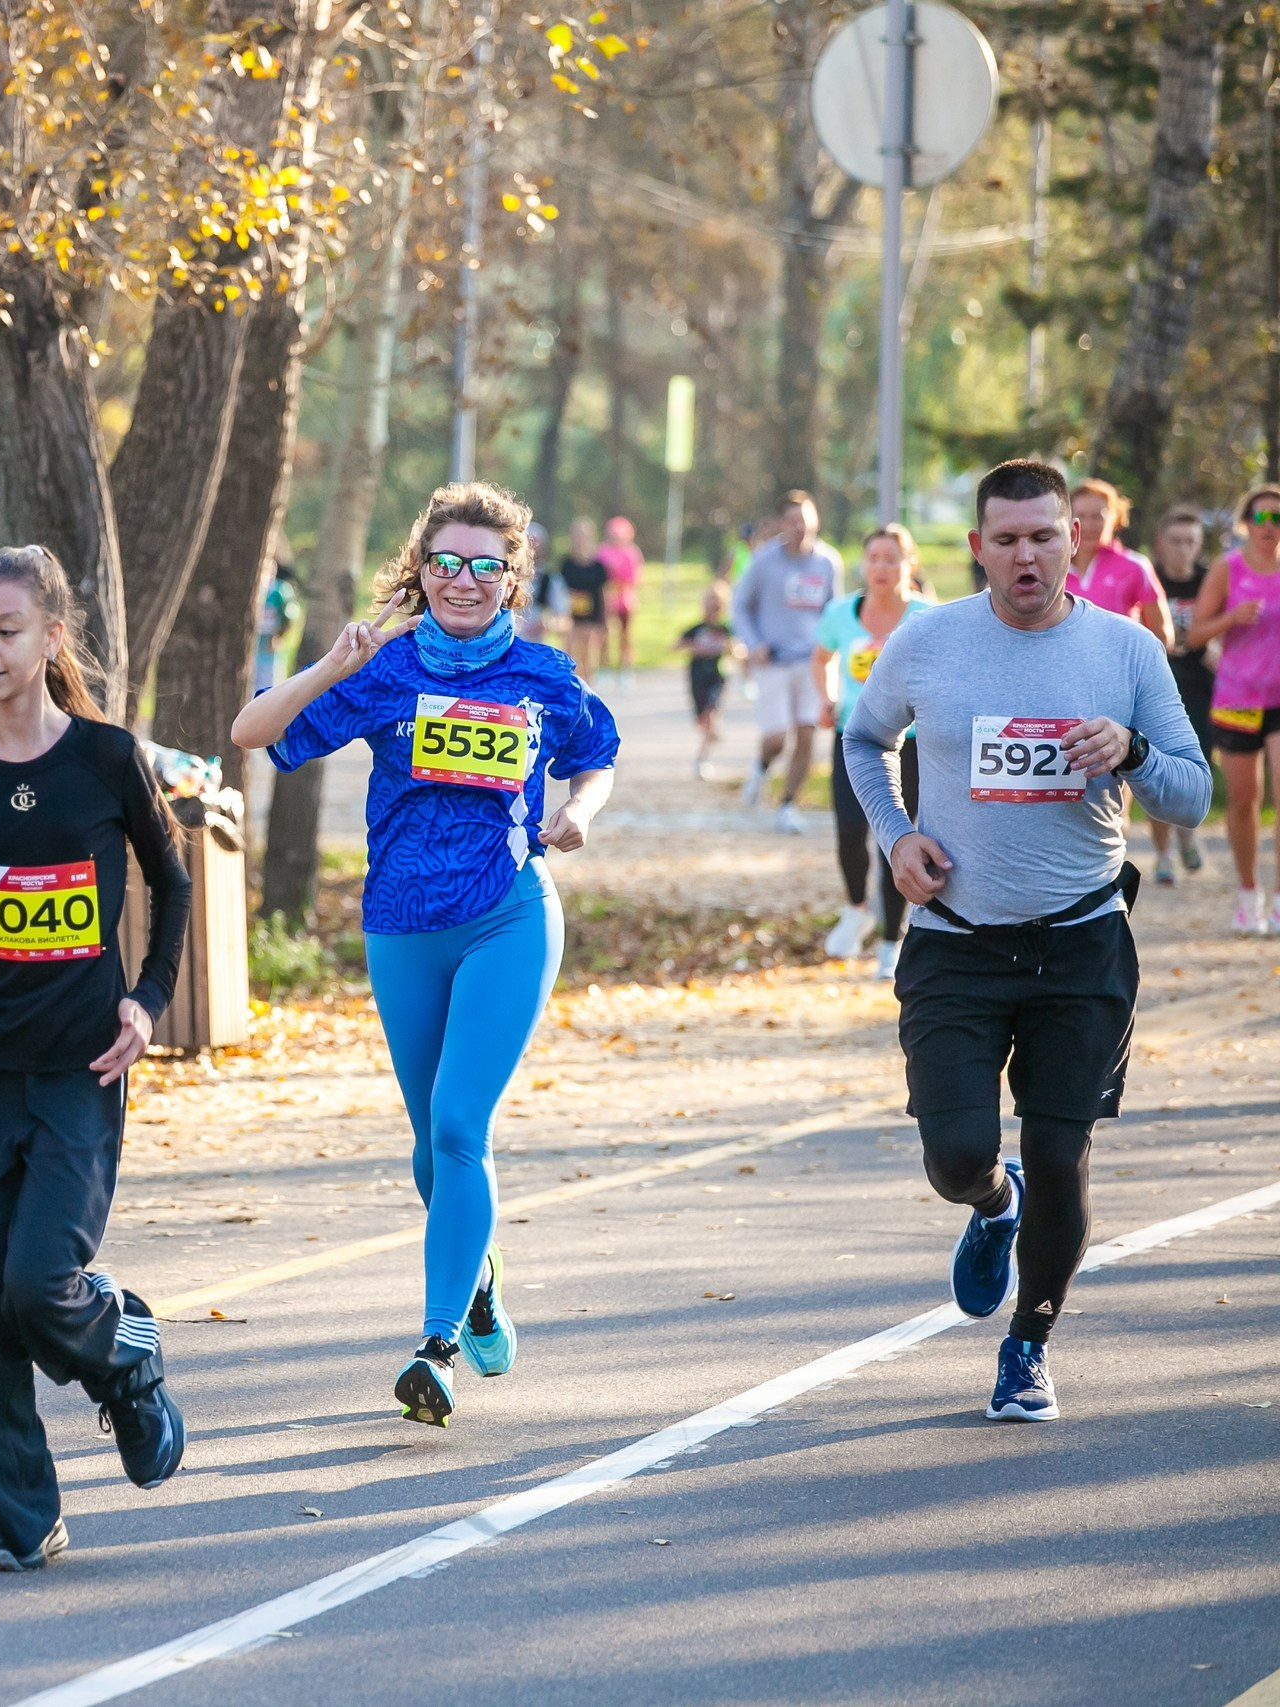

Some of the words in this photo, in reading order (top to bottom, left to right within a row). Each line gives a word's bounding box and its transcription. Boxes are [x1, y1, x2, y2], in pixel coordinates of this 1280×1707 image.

[422, 722, 519, 765] 5532
[8, 873, 56, 881] КРАСНОЯРСКИЕ
[38, 934, 80, 944] ВИОЛЕТТА
